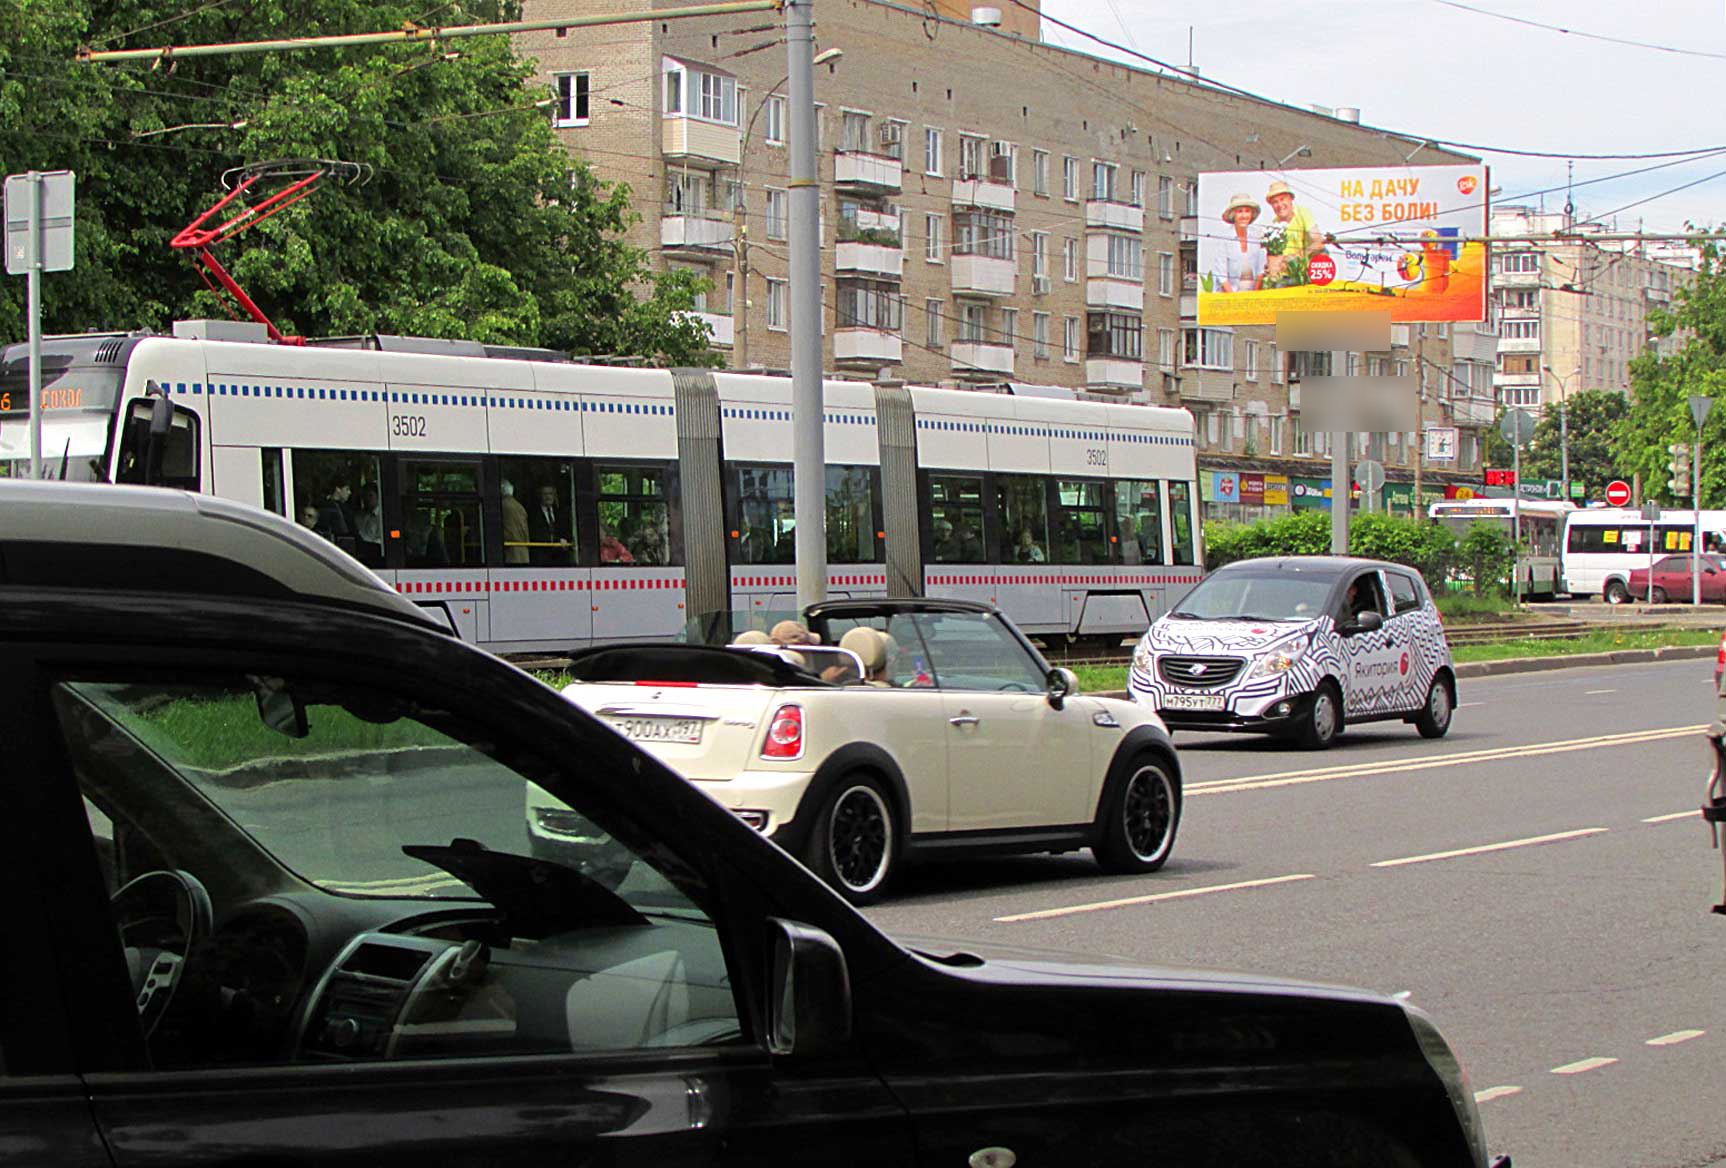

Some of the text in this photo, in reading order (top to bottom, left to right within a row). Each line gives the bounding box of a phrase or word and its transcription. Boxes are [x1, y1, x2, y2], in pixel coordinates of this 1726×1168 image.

[1340, 177, 1420, 200] НА ДАЧУ
[1340, 201, 1438, 223] БЕЗ БОЛИ!
[1310, 269, 1333, 280] 25%
[392, 415, 427, 437] 3502
[1086, 448, 1107, 466] 3502
